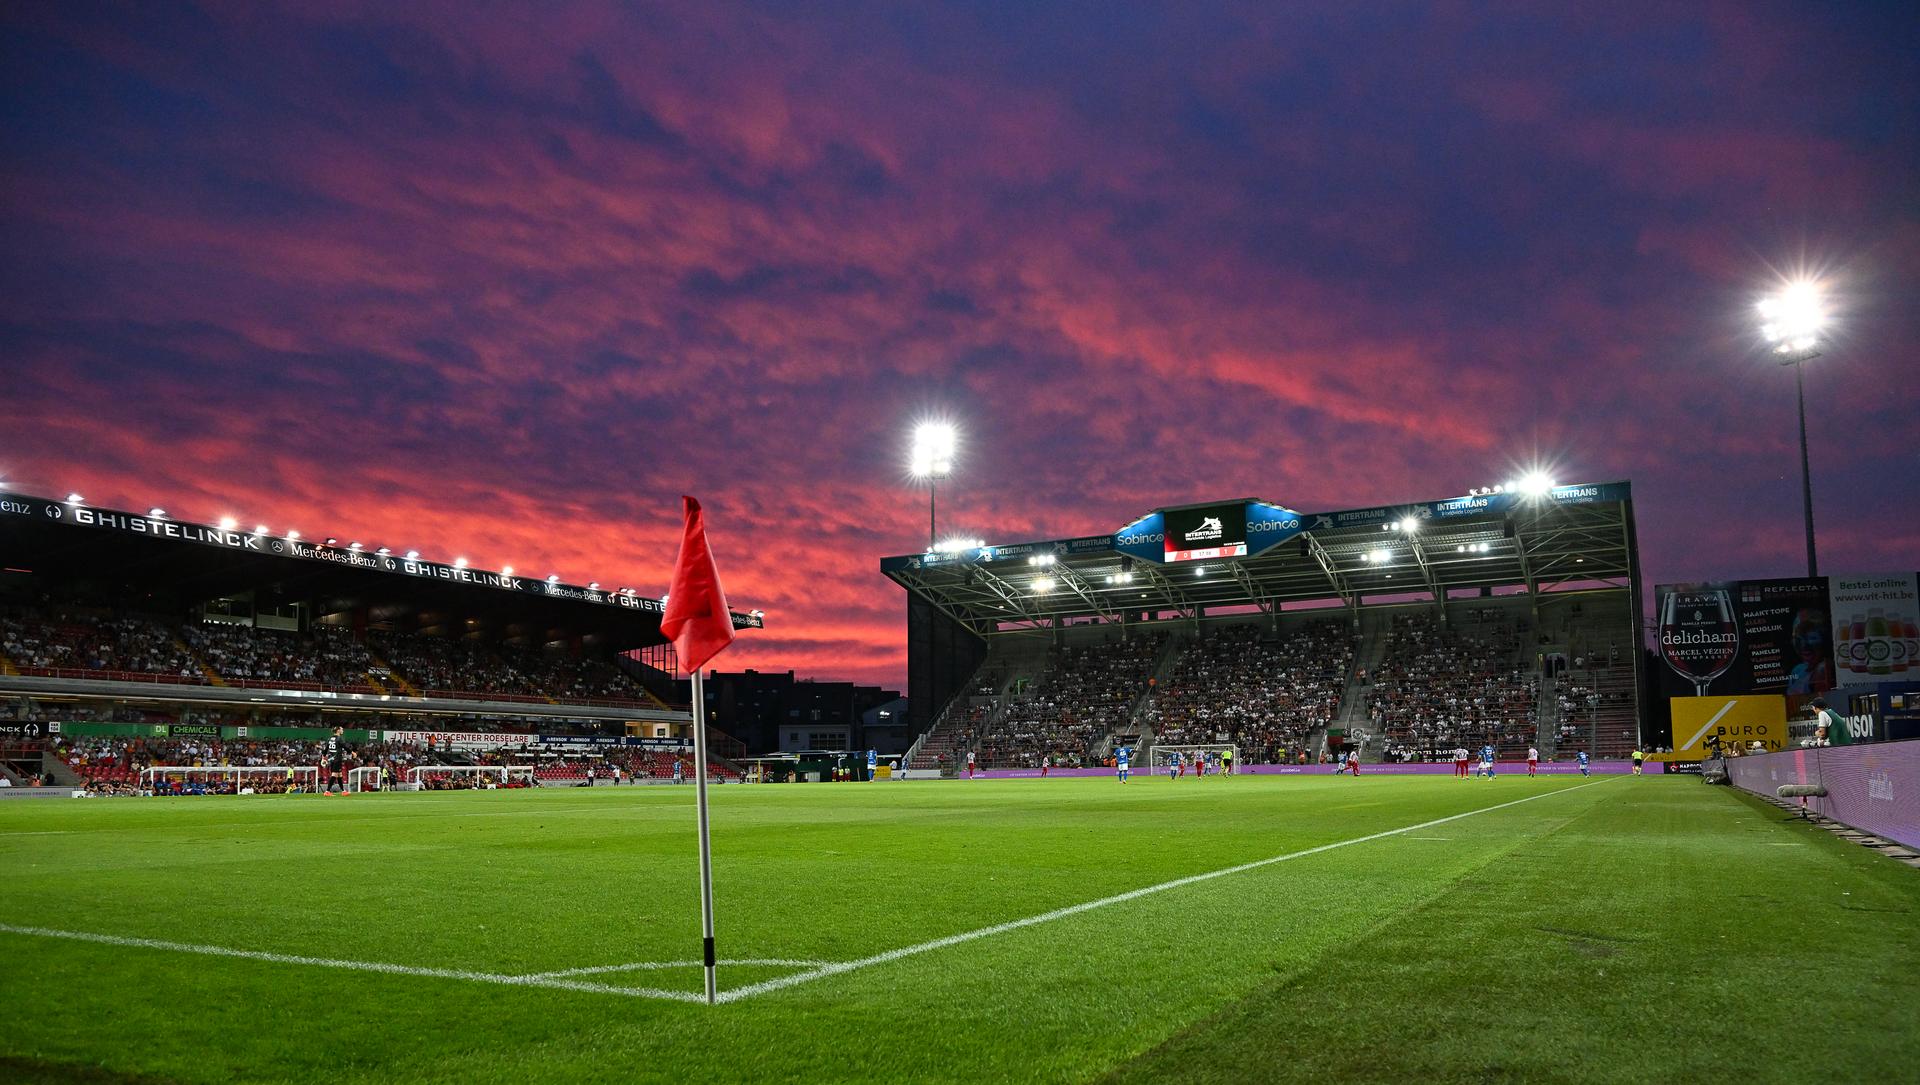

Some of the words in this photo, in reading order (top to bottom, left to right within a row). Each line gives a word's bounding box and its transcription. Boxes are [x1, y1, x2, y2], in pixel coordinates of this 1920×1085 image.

[1552, 488, 1598, 499] TERTRANS
[1, 500, 31, 515] enz
[1437, 499, 1488, 511] INTERTRANS
[1338, 509, 1385, 521] INTERTRANS
[75, 509, 260, 550] GHISTELINCK
[1246, 519, 1299, 533] Sobinco
[1117, 532, 1164, 546] Sobinco
[1185, 530, 1222, 539] INTERTRANS
[1072, 538, 1111, 548] INTERTRANS
[291, 543, 377, 568] Mercedes-Benz
[996, 545, 1033, 556] INTERTRANS
[404, 561, 523, 590] GHISTELINCK
[1764, 585, 1819, 593] REFLECTA
[1840, 580, 1871, 590] Bestel
[1874, 579, 1908, 588] online
[544, 584, 603, 603] Mercedes-Benz
[1835, 591, 1914, 602] www.vit-hit.be
[620, 596, 667, 612] GHISTE
[1743, 609, 1769, 618] MAAKT
[1662, 630, 1737, 645] delicham
[1751, 648, 1781, 656] PANELEN
[1754, 662, 1781, 670] DOEKEN
[155, 725, 167, 733] DL
[173, 726, 217, 734] CHEMICALS
[1717, 725, 1768, 736] BURO
[1846, 714, 1874, 738] NSON
[399, 732, 417, 740] TILE
[450, 733, 481, 742] CENTER
[484, 734, 529, 743] ROESELARE
[328, 741, 337, 750] 26
[1703, 739, 1781, 750] MOERN
